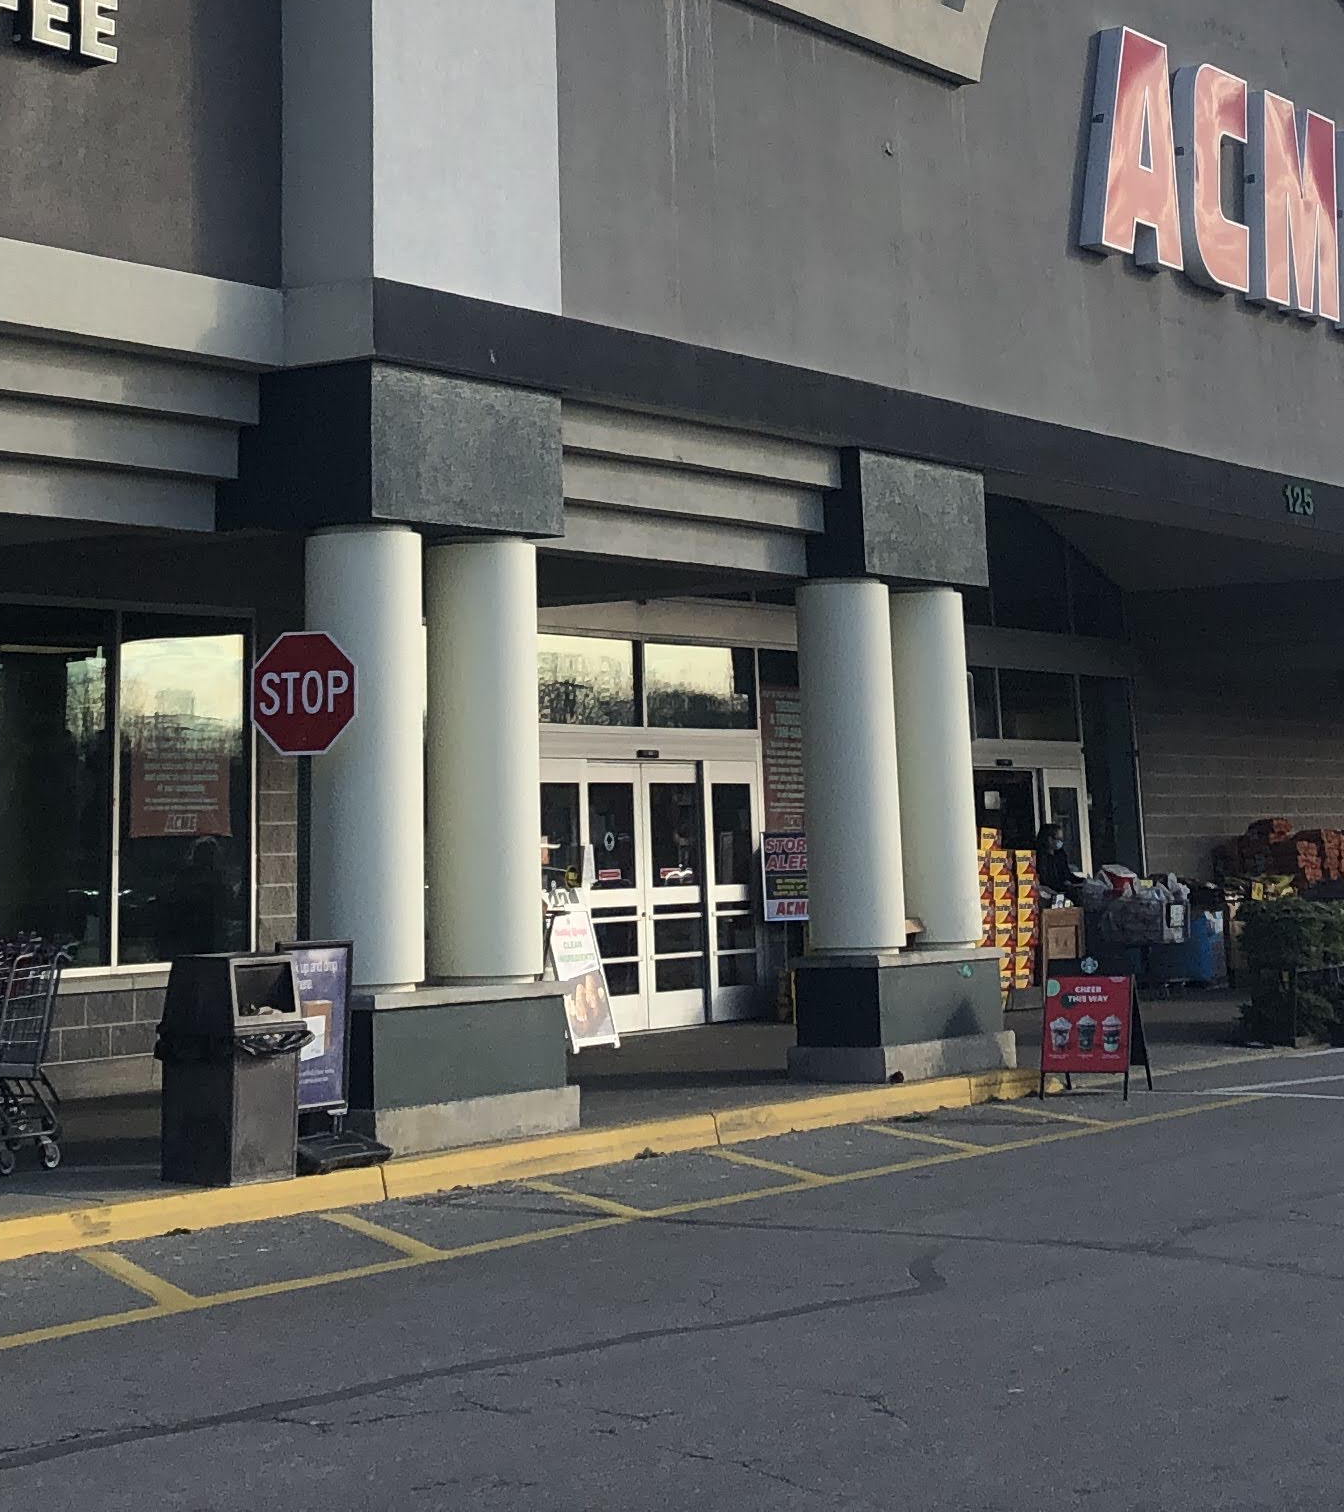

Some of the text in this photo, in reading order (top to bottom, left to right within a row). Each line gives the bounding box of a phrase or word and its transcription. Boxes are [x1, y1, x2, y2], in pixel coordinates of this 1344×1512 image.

[1286, 485, 1314, 515] 125
[259, 670, 349, 716] STOP
[764, 837, 807, 854] STOR
[776, 900, 808, 916] ACM
[1074, 986, 1102, 994] CHEER
[1088, 995, 1109, 1003] WAY
